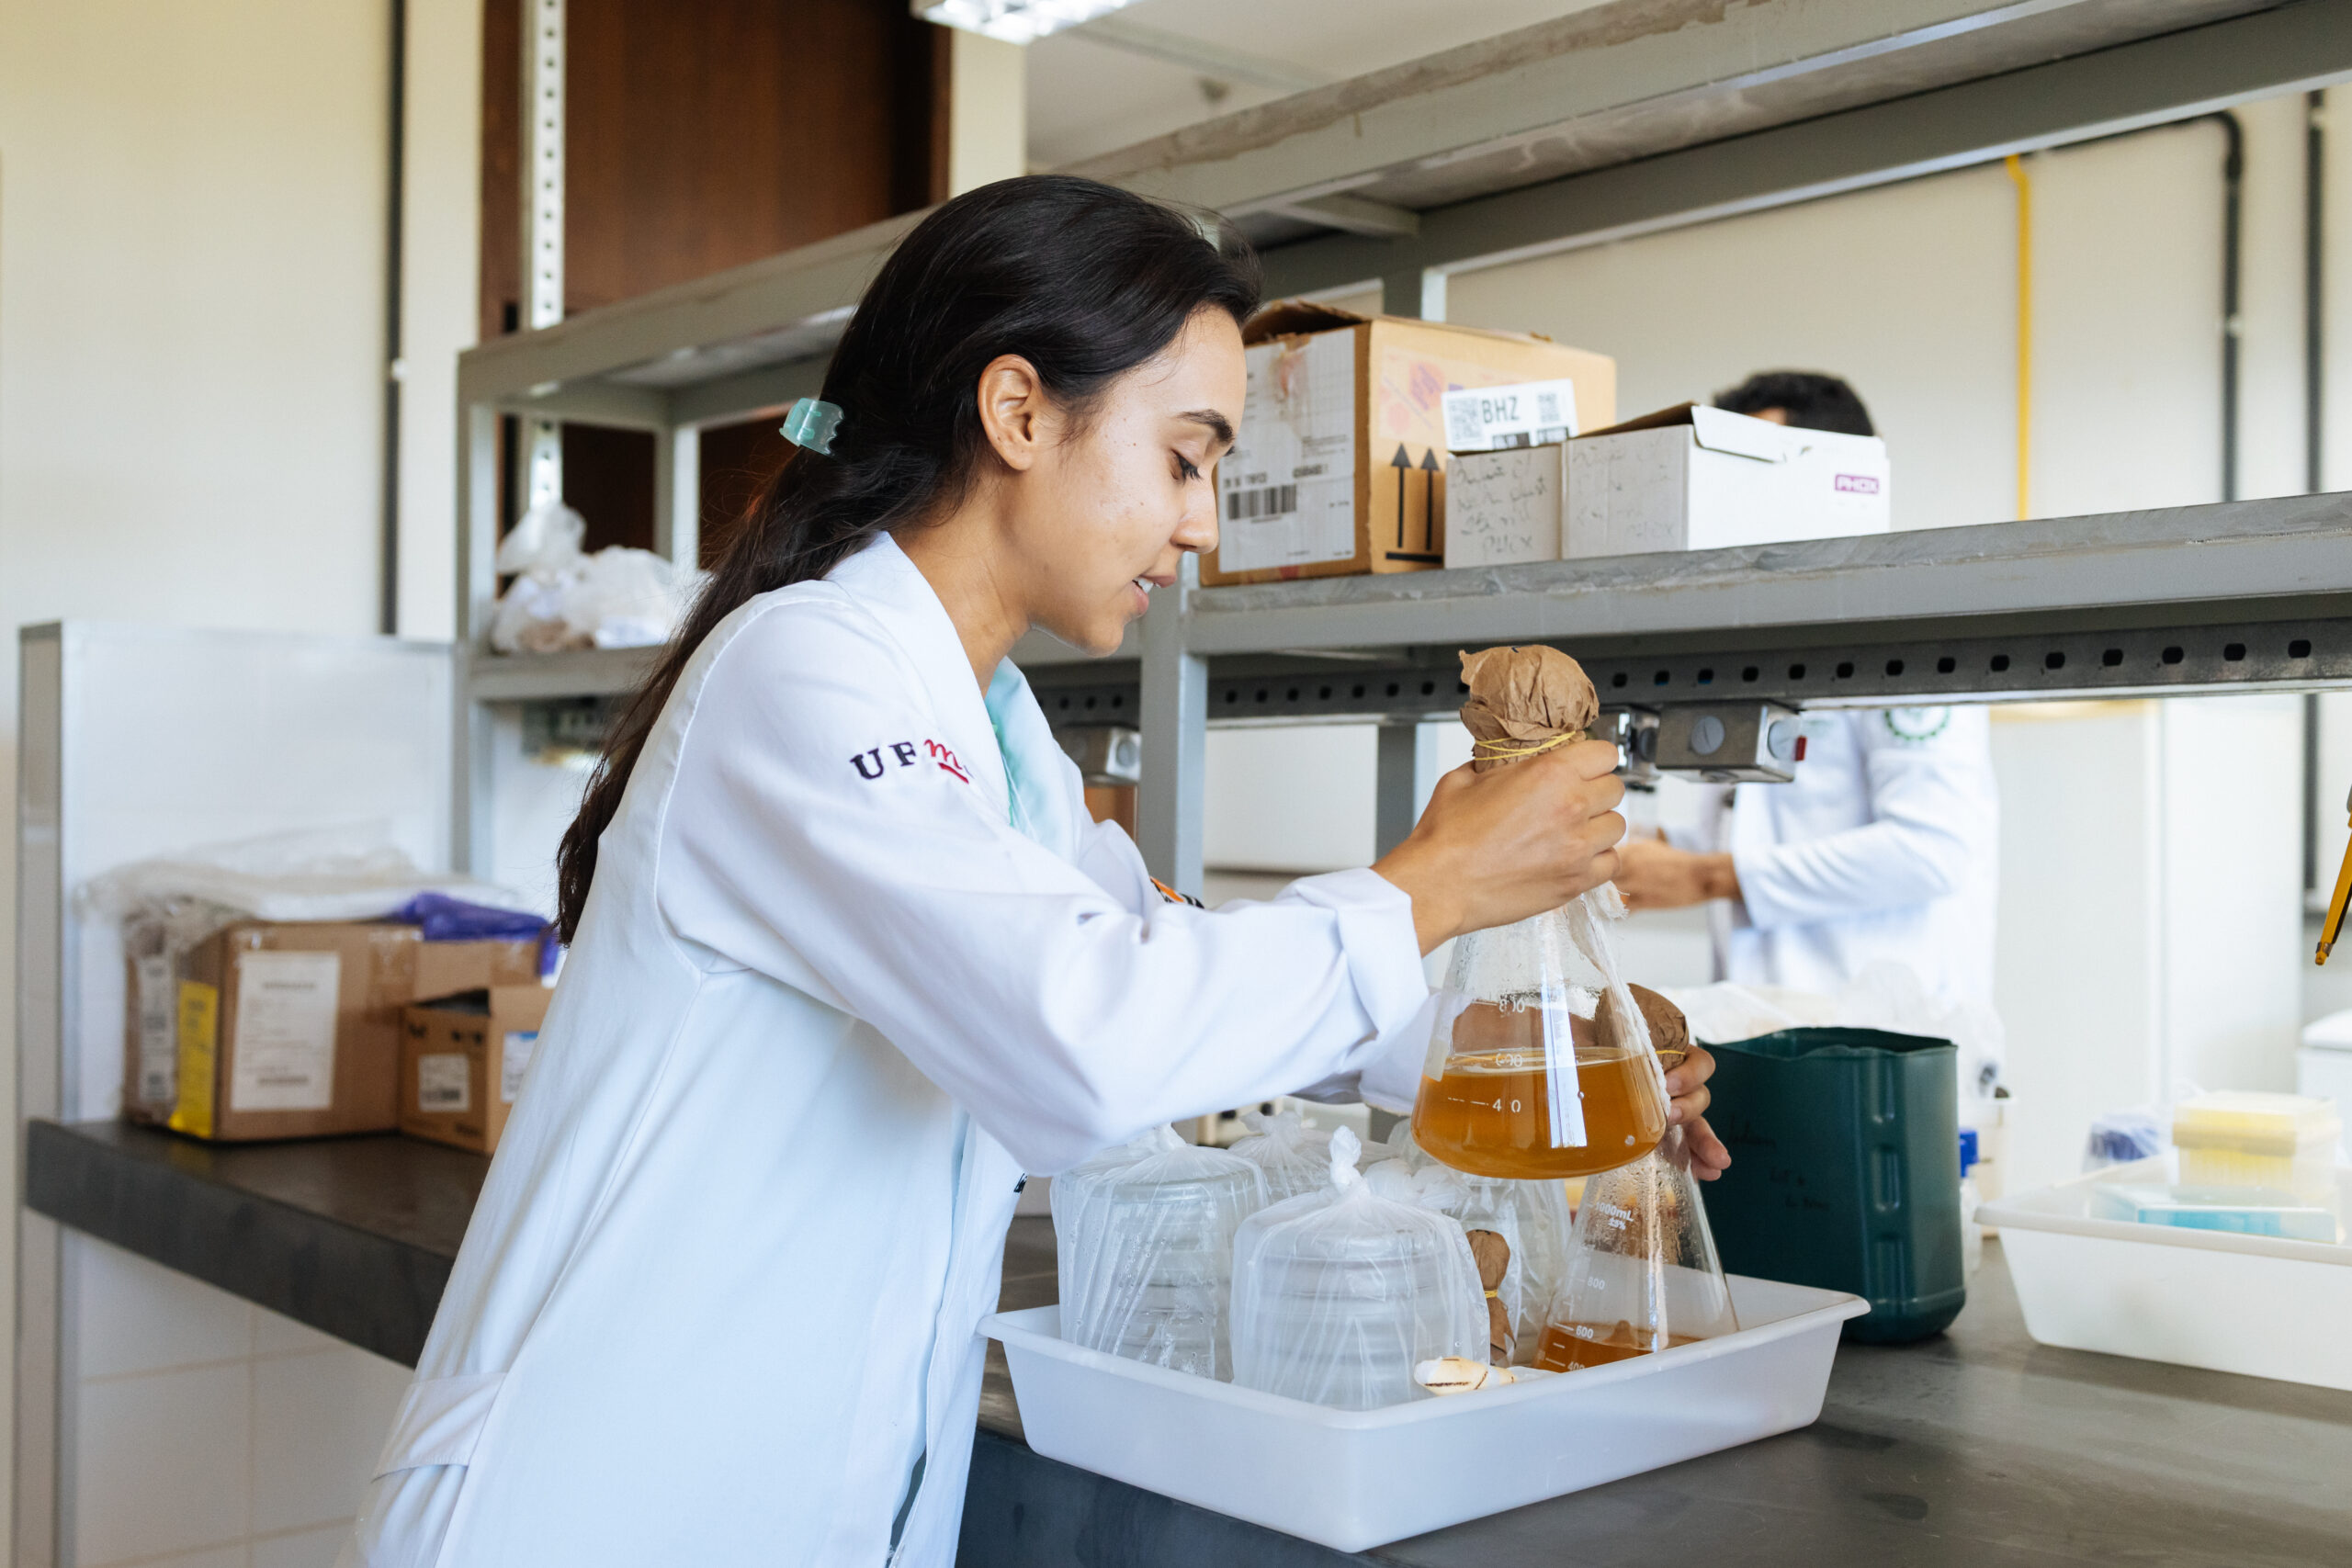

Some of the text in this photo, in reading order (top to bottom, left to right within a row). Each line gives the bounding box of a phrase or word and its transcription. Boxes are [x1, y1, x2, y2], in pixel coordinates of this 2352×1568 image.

[1481, 395, 1521, 423] BHZ
[1838, 475, 1878, 493] PHOX
[1595, 1201, 1634, 1222] 1000mL
[1588, 1276, 1605, 1291] 800
[1576, 1325, 1594, 1339] 600
